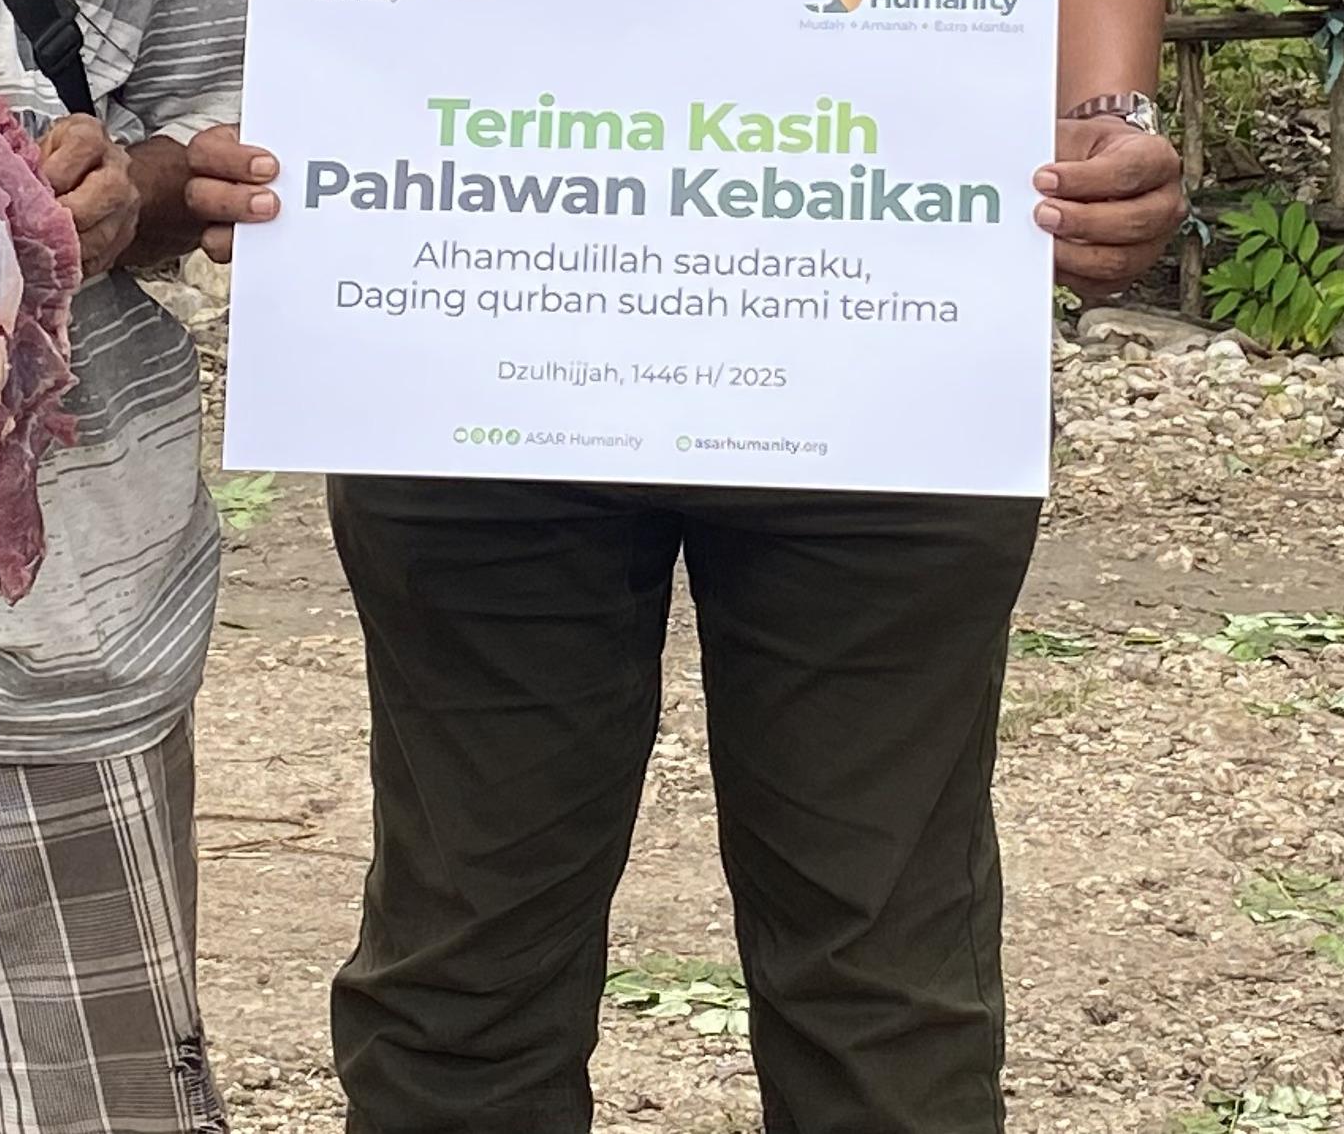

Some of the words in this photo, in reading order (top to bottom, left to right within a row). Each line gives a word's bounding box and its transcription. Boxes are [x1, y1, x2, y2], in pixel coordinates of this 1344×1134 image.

[861, 20, 917, 32] Amanah
[428, 93, 664, 151] Terima
[690, 97, 878, 154] Kasih
[305, 159, 646, 216] Pahlawan
[670, 164, 1001, 224] Kebaikan
[413, 240, 662, 275] Alhamdulillah
[673, 248, 872, 283] saudaraku,
[336, 280, 466, 318] Daging
[477, 284, 607, 319] qurban
[618, 287, 728, 317] sudah
[741, 289, 830, 320] kami
[840, 292, 959, 323] terima
[498, 360, 624, 386] Dzulhijjah,
[631, 364, 688, 385] 1446
[695, 362, 725, 388] H/
[728, 366, 787, 387] 2025
[524, 430, 566, 446] ASAR
[569, 432, 644, 451] Humanity
[694, 436, 828, 456] asarhumanity.org
